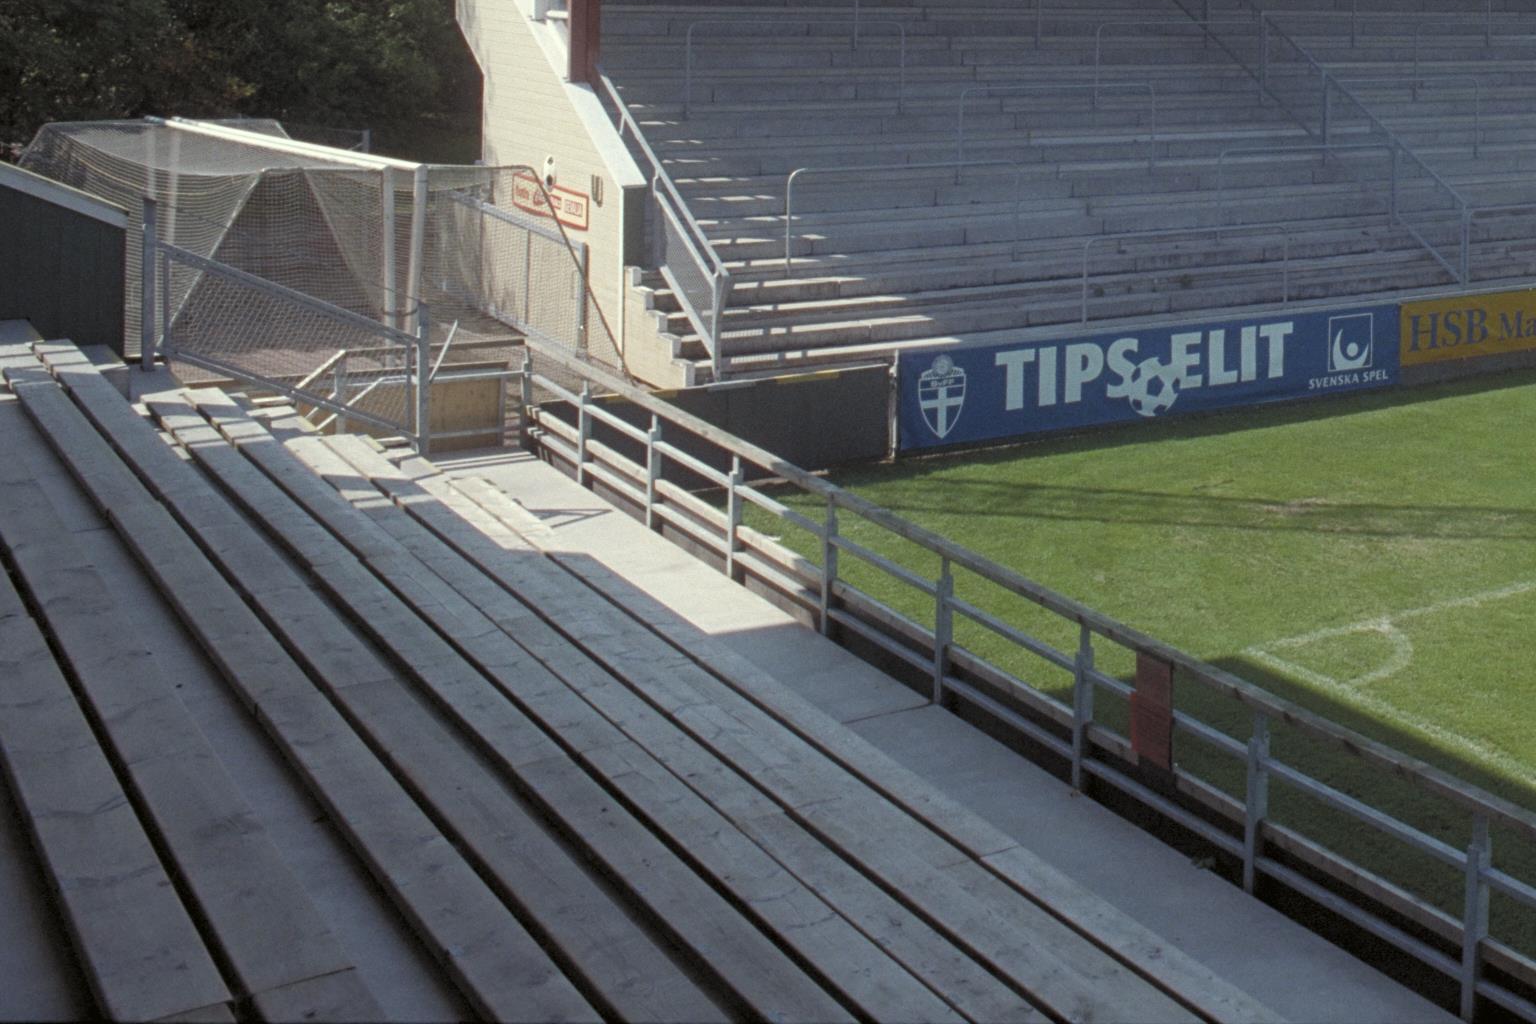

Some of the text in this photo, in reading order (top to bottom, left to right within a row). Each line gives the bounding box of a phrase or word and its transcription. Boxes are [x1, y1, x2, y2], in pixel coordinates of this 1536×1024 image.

[1408, 308, 1489, 353] HSB
[1308, 369, 1389, 390] SVENSKA SPEL
